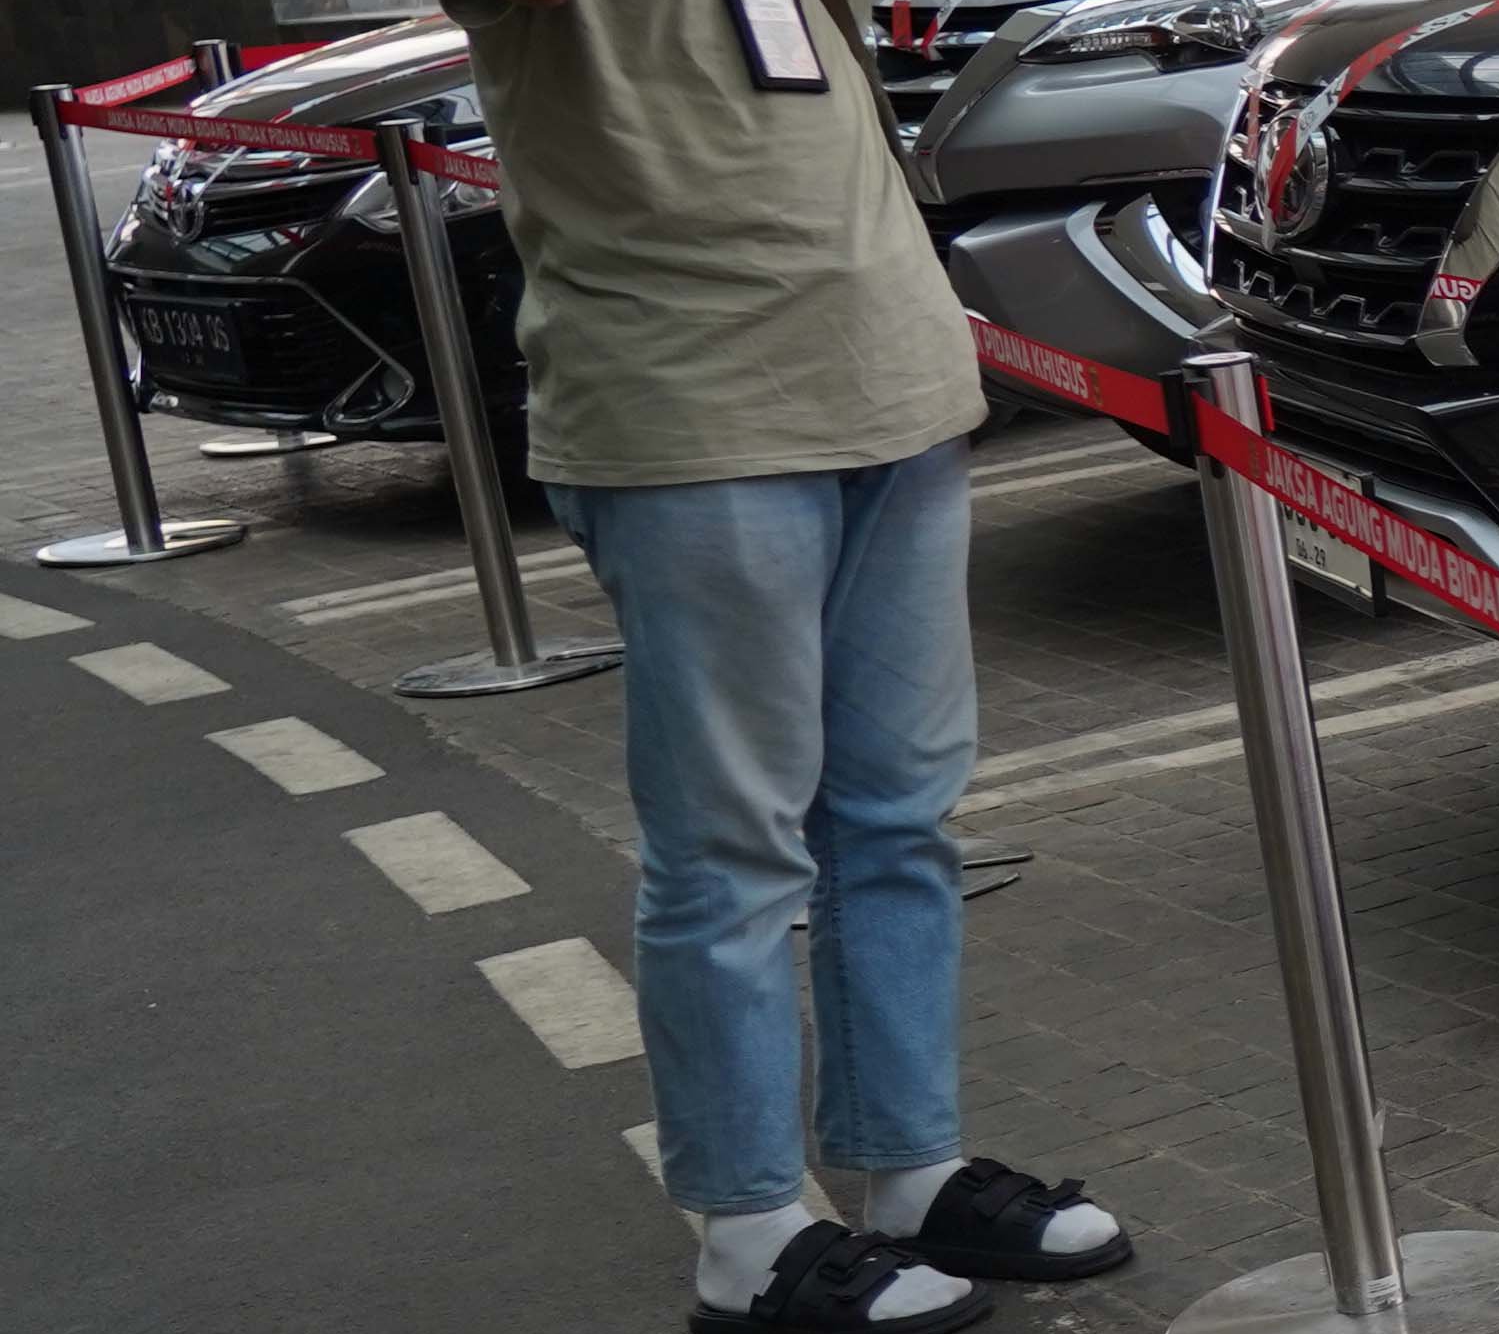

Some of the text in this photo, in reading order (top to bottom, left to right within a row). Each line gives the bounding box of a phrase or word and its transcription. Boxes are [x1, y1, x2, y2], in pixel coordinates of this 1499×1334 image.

[982, 323, 1034, 374] PIDANA
[1030, 342, 1089, 399] KHUSUS
[1265, 446, 1320, 515] JAKSA
[1321, 478, 1384, 554] AGUNG
[1384, 514, 1446, 590] MUDA
